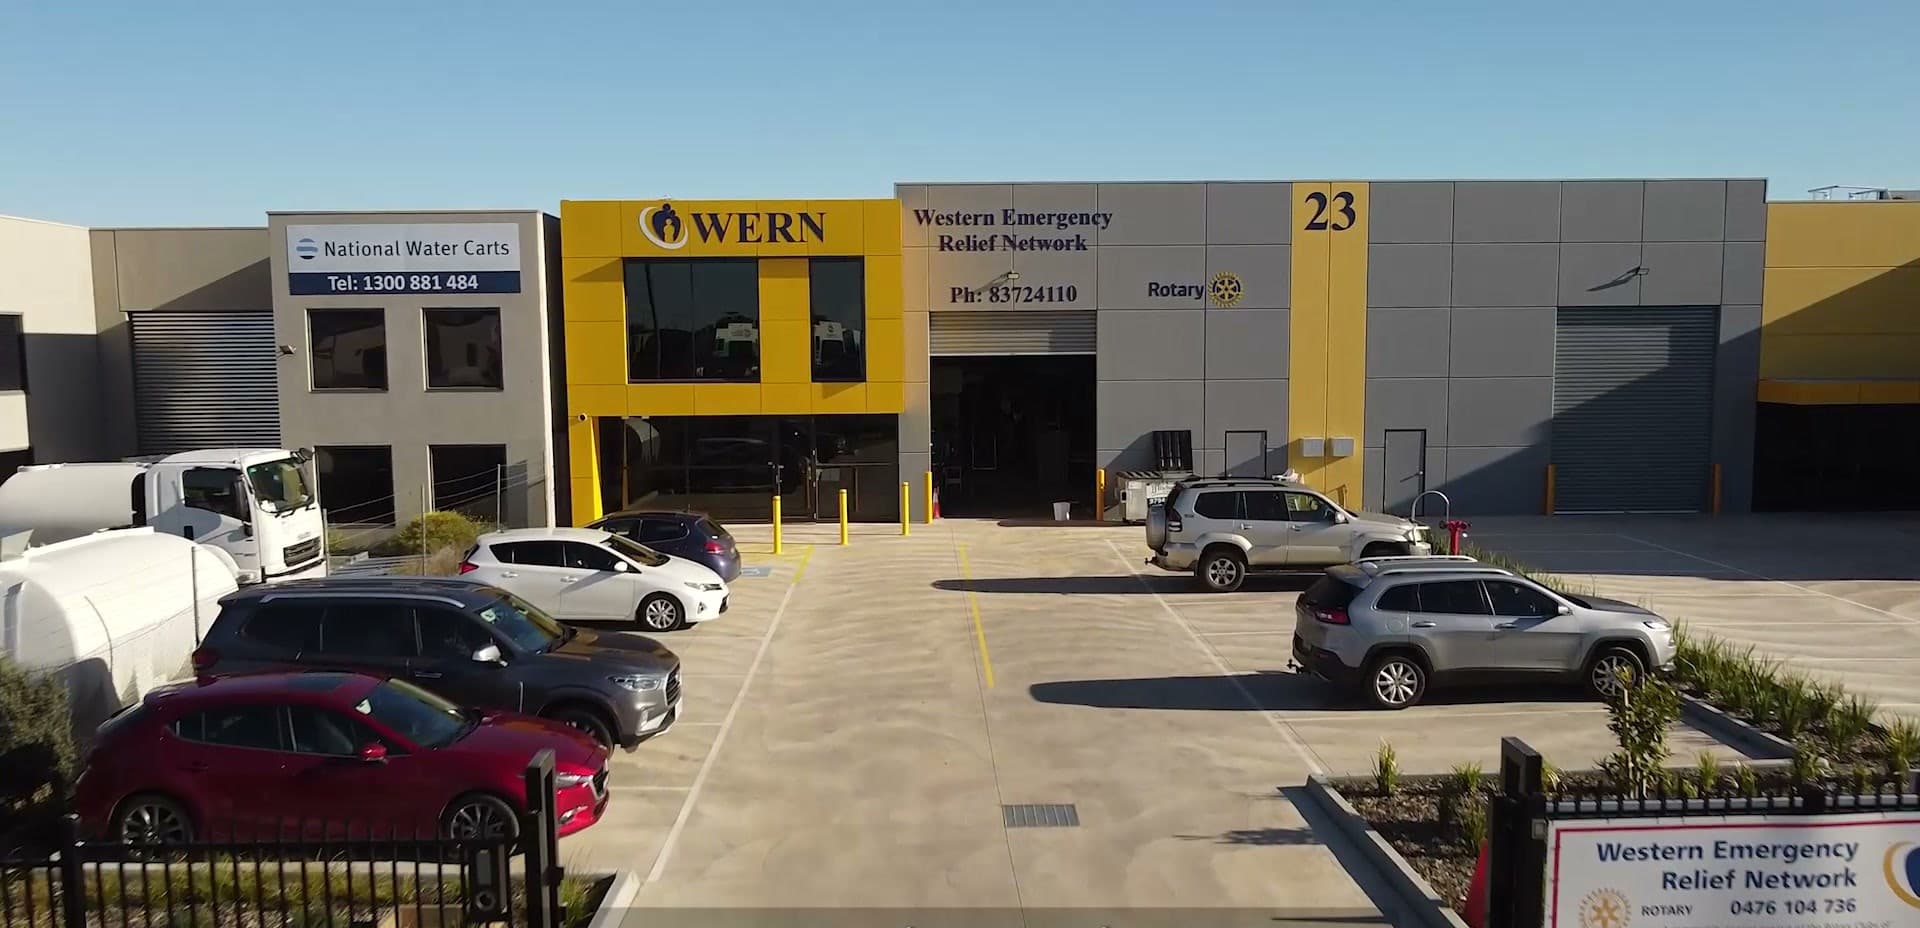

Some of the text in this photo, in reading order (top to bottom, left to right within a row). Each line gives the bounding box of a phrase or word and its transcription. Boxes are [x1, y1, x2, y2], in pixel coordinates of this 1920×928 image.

[913, 208, 1113, 230] Western Emergency
[1304, 191, 1357, 231] 23
[691, 212, 826, 243] WERN
[324, 239, 510, 257] National Water Carts
[938, 234, 1088, 252] Relief Network
[327, 274, 479, 291] Tel: 1300 881 484
[1147, 281, 1205, 300] Rotary
[950, 285, 1078, 304] Ph: 83724110
[1597, 841, 1858, 865] Western Emergency
[1662, 867, 1857, 891] Relief Network
[1641, 898, 1856, 917] ROTARY 0476 104 736
